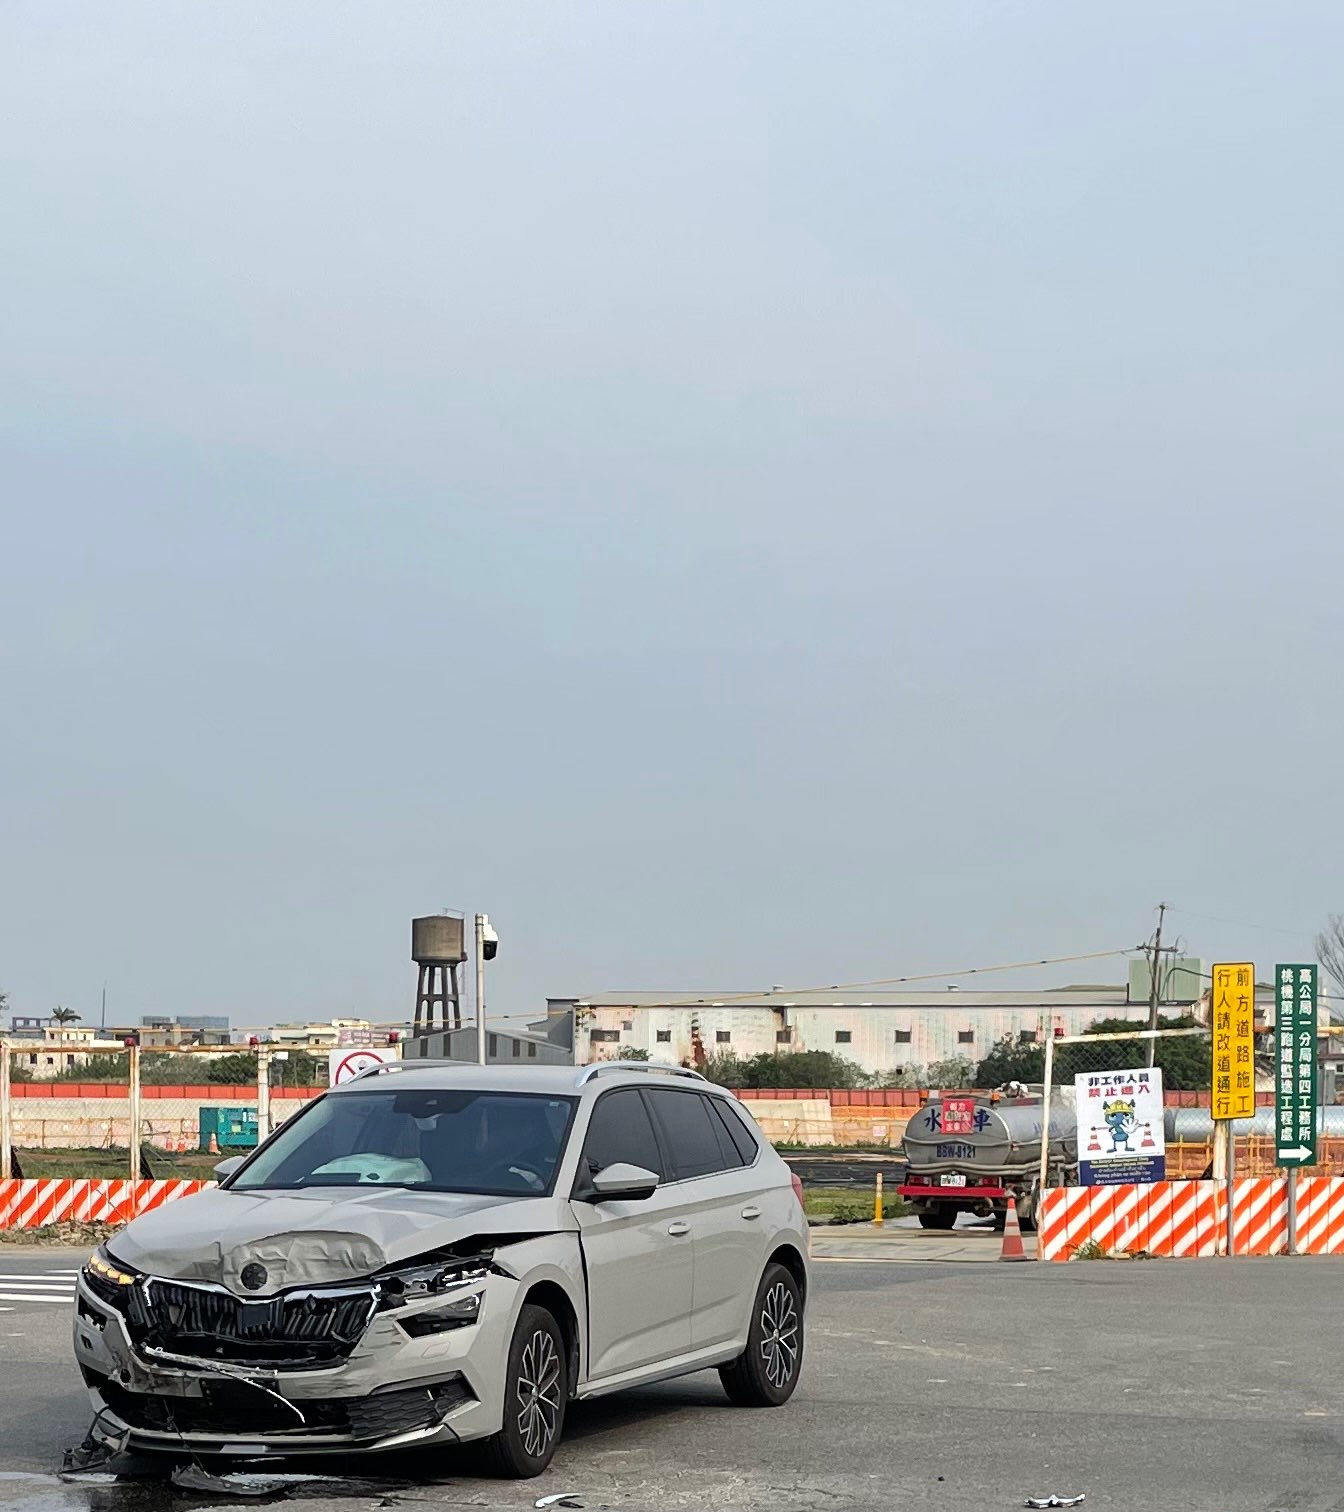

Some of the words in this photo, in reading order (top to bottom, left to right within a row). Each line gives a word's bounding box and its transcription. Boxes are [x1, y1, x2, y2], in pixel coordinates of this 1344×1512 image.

[1088, 1073, 1149, 1086] 非工作人員
[1217, 969, 1231, 1115] 行人請改道通行
[1237, 968, 1250, 1114] 前方道路施工
[1088, 1085, 1150, 1098] 禁止進入
